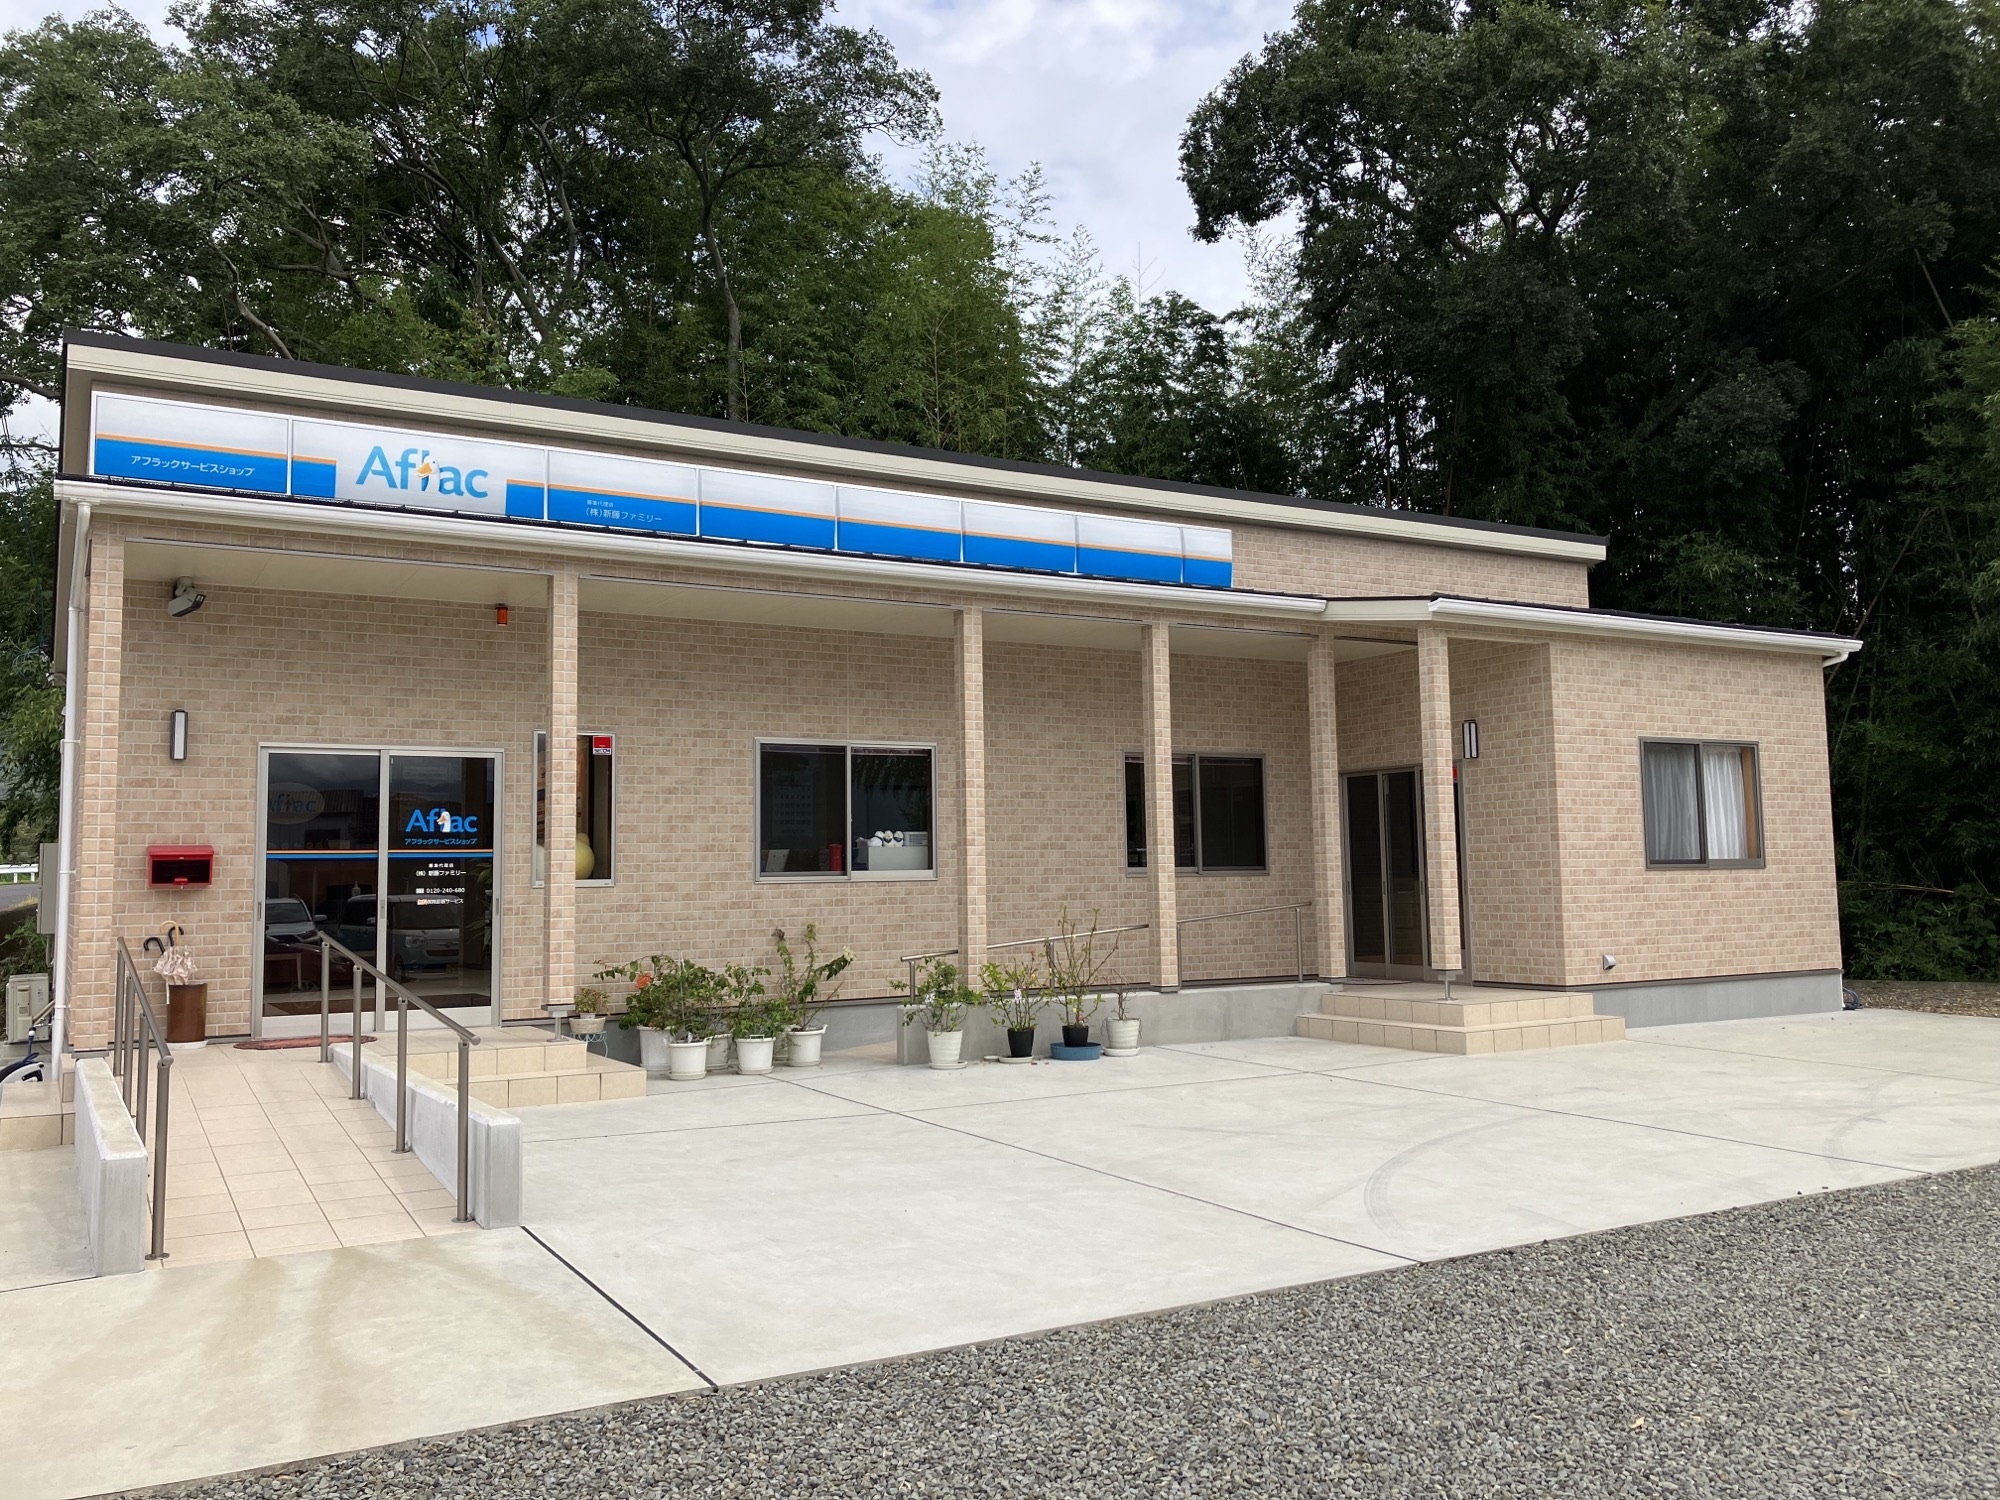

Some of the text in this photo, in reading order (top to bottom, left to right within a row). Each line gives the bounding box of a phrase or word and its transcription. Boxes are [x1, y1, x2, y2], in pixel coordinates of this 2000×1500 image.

[130, 455, 256, 477] アフラックサービスショップ
[404, 837, 478, 845] アフラックサービスショップ
